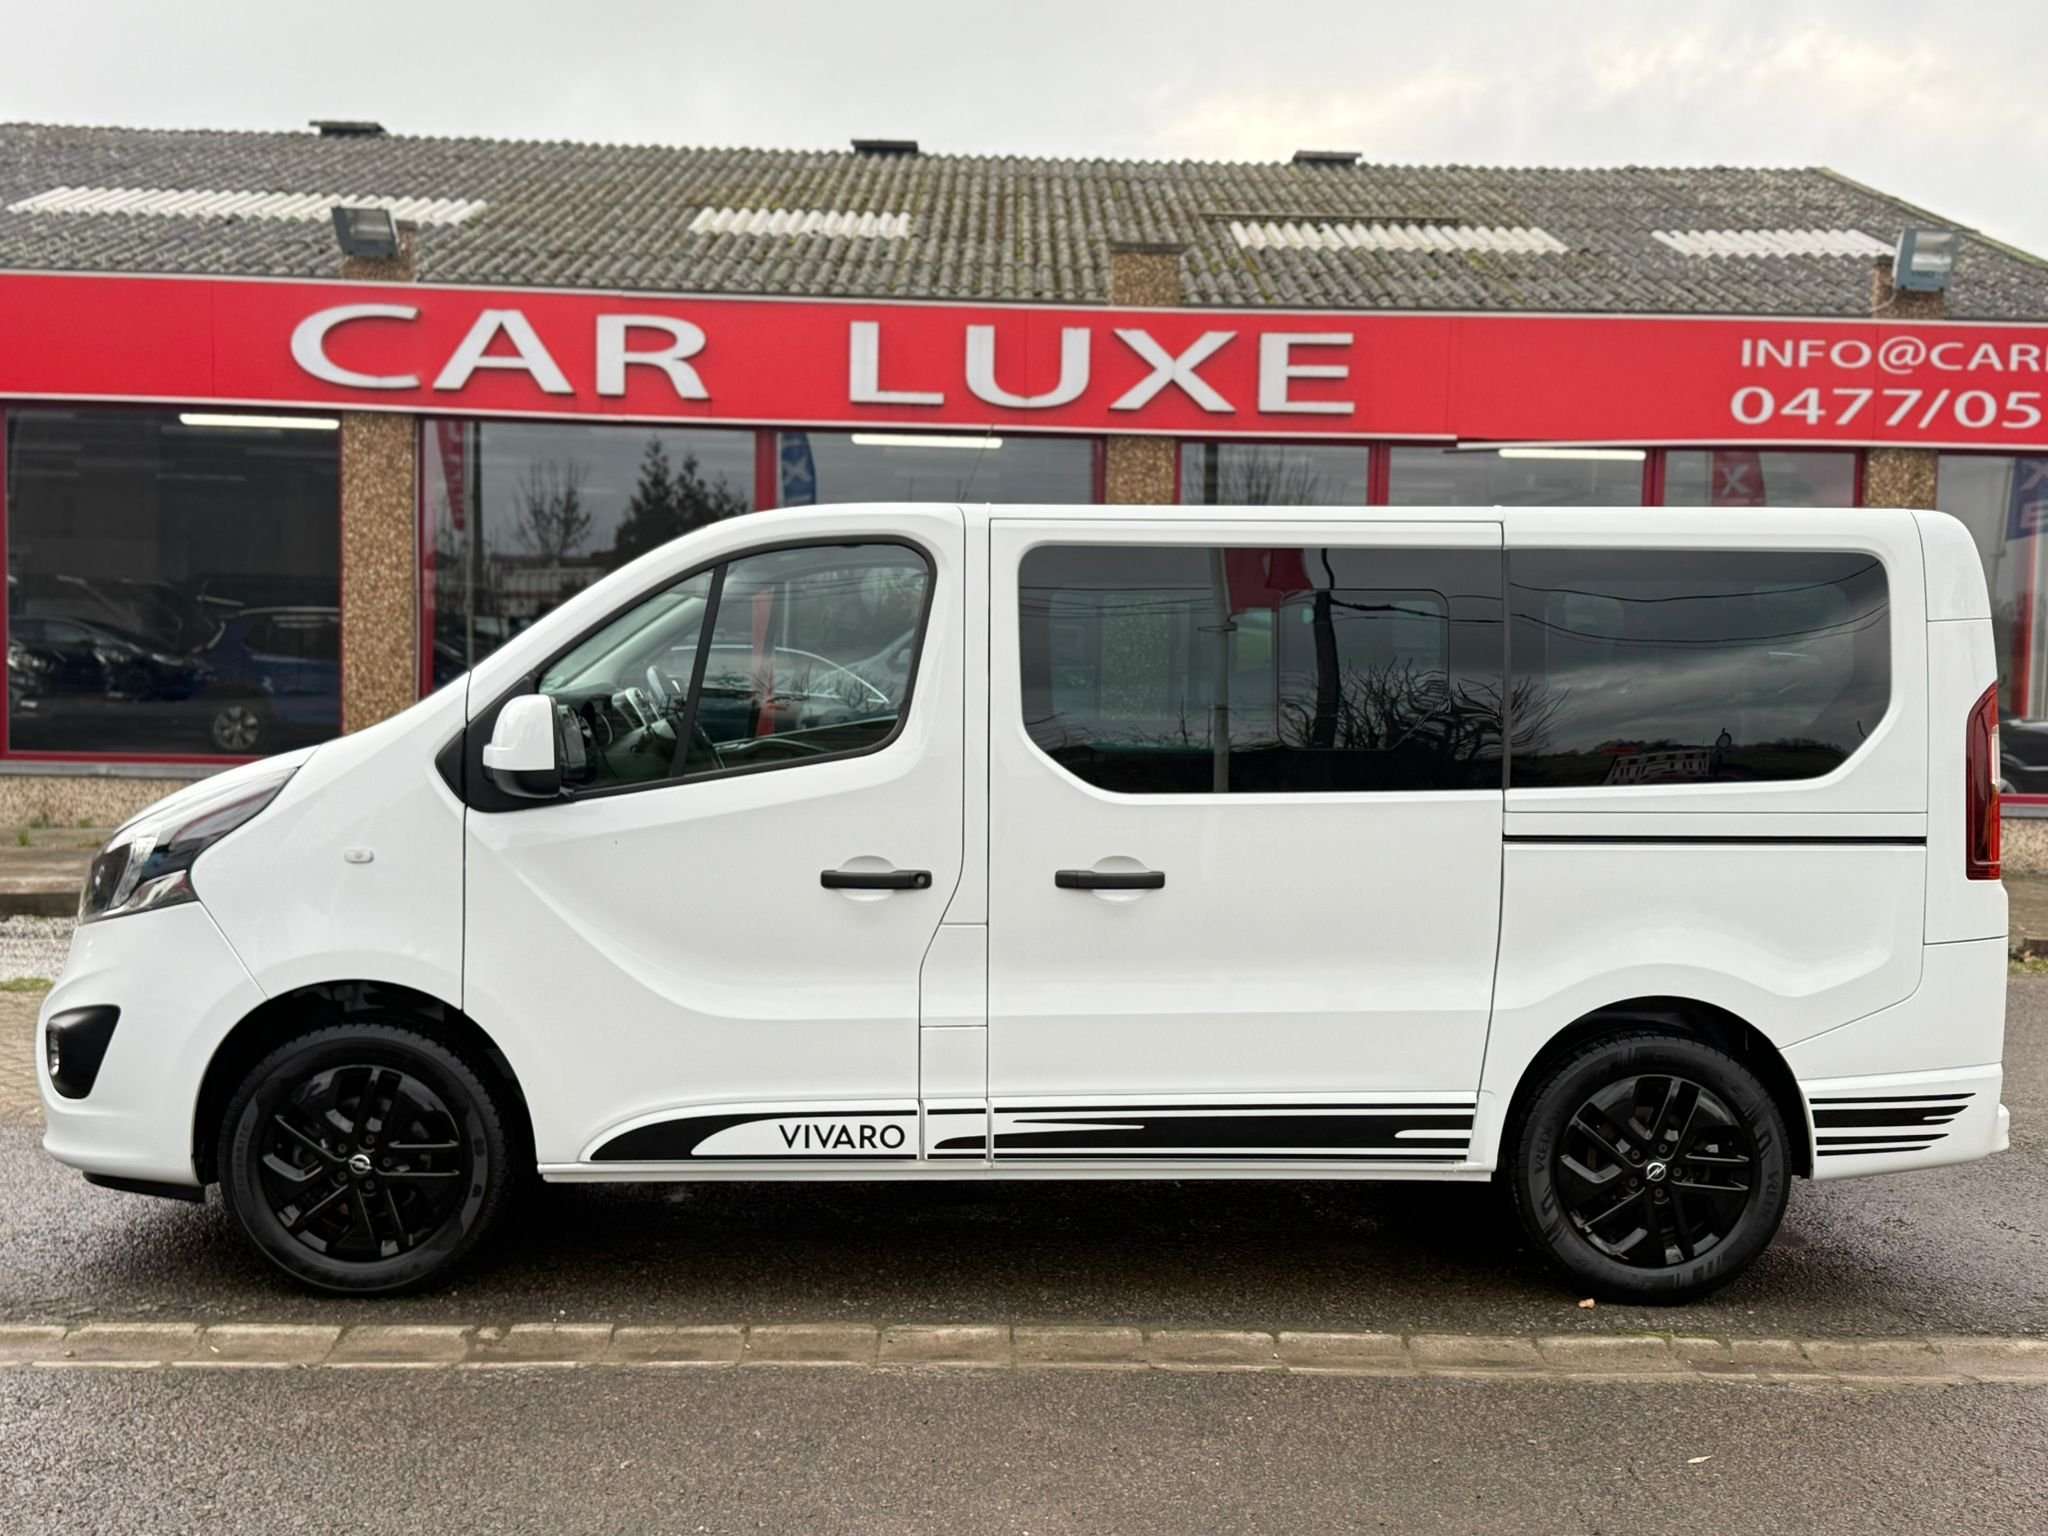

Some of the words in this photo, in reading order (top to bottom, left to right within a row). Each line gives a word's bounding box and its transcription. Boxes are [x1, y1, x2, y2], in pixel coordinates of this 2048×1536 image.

[290, 303, 710, 399] CAR
[849, 321, 1356, 413] LUXE
[1741, 336, 2048, 374] INFO@CAR
[1730, 386, 2042, 429] 0477/05
[778, 1124, 906, 1149] VIVARO
